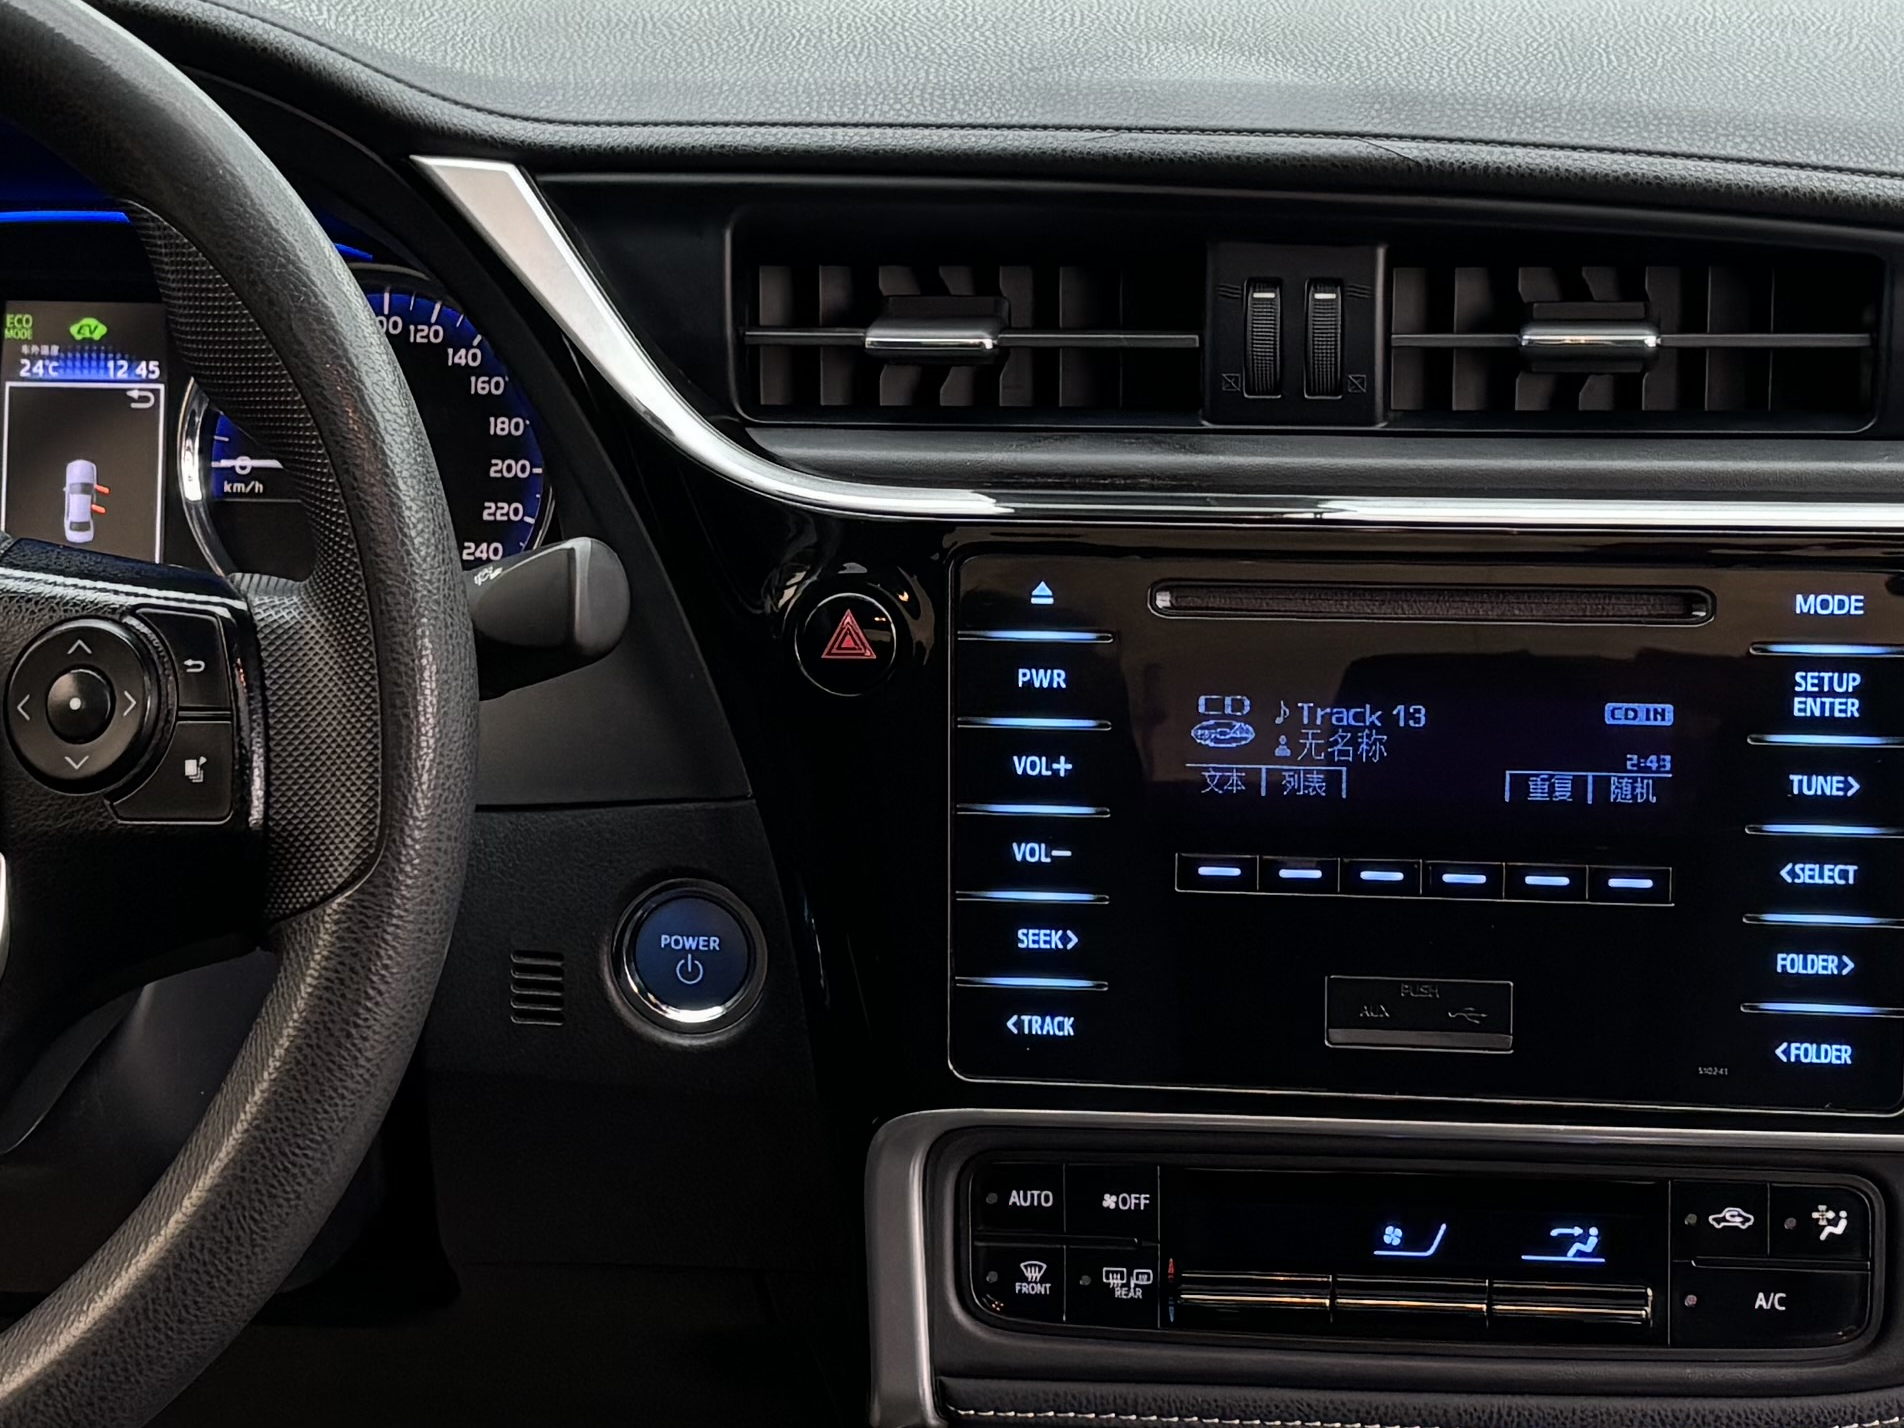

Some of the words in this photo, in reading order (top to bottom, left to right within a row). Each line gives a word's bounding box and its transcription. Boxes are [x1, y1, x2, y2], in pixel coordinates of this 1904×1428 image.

[5, 314, 33, 329] ECO
[409, 324, 444, 344] 120
[447, 348, 482, 368] 140
[470, 376, 503, 395] 160
[489, 416, 525, 436] 180
[489, 458, 531, 479] 200
[223, 479, 264, 495] km/h
[482, 501, 524, 521] 220
[462, 542, 503, 561] 240
[1795, 594, 1864, 615] MODE
[1018, 667, 1067, 689] PWR
[1794, 671, 1861, 693] SETUP
[1196, 694, 1252, 716] CD
[1297, 702, 1383, 728] Track
[1392, 704, 1427, 728] 13
[1610, 707, 1639, 721] CD
[1645, 707, 1666, 722] IN
[1793, 696, 1860, 718] ENTER
[1297, 729, 1388, 763] 无名称
[1200, 768, 1246, 795] 文本
[1282, 769, 1327, 796] 列表
[1527, 776, 1574, 803] 重复
[1610, 777, 1657, 803] 随机
[660, 934, 720, 952] POWER
[1400, 983, 1440, 999] PUSH
[1359, 1004, 1390, 1020] AUX
[1008, 1189, 1054, 1208] AUTO
[1118, 1192, 1151, 1211] OFF
[1014, 1282, 1052, 1295] FRONT
[1114, 1286, 1143, 1300] REAR
[1754, 1291, 1787, 1311] A/C
